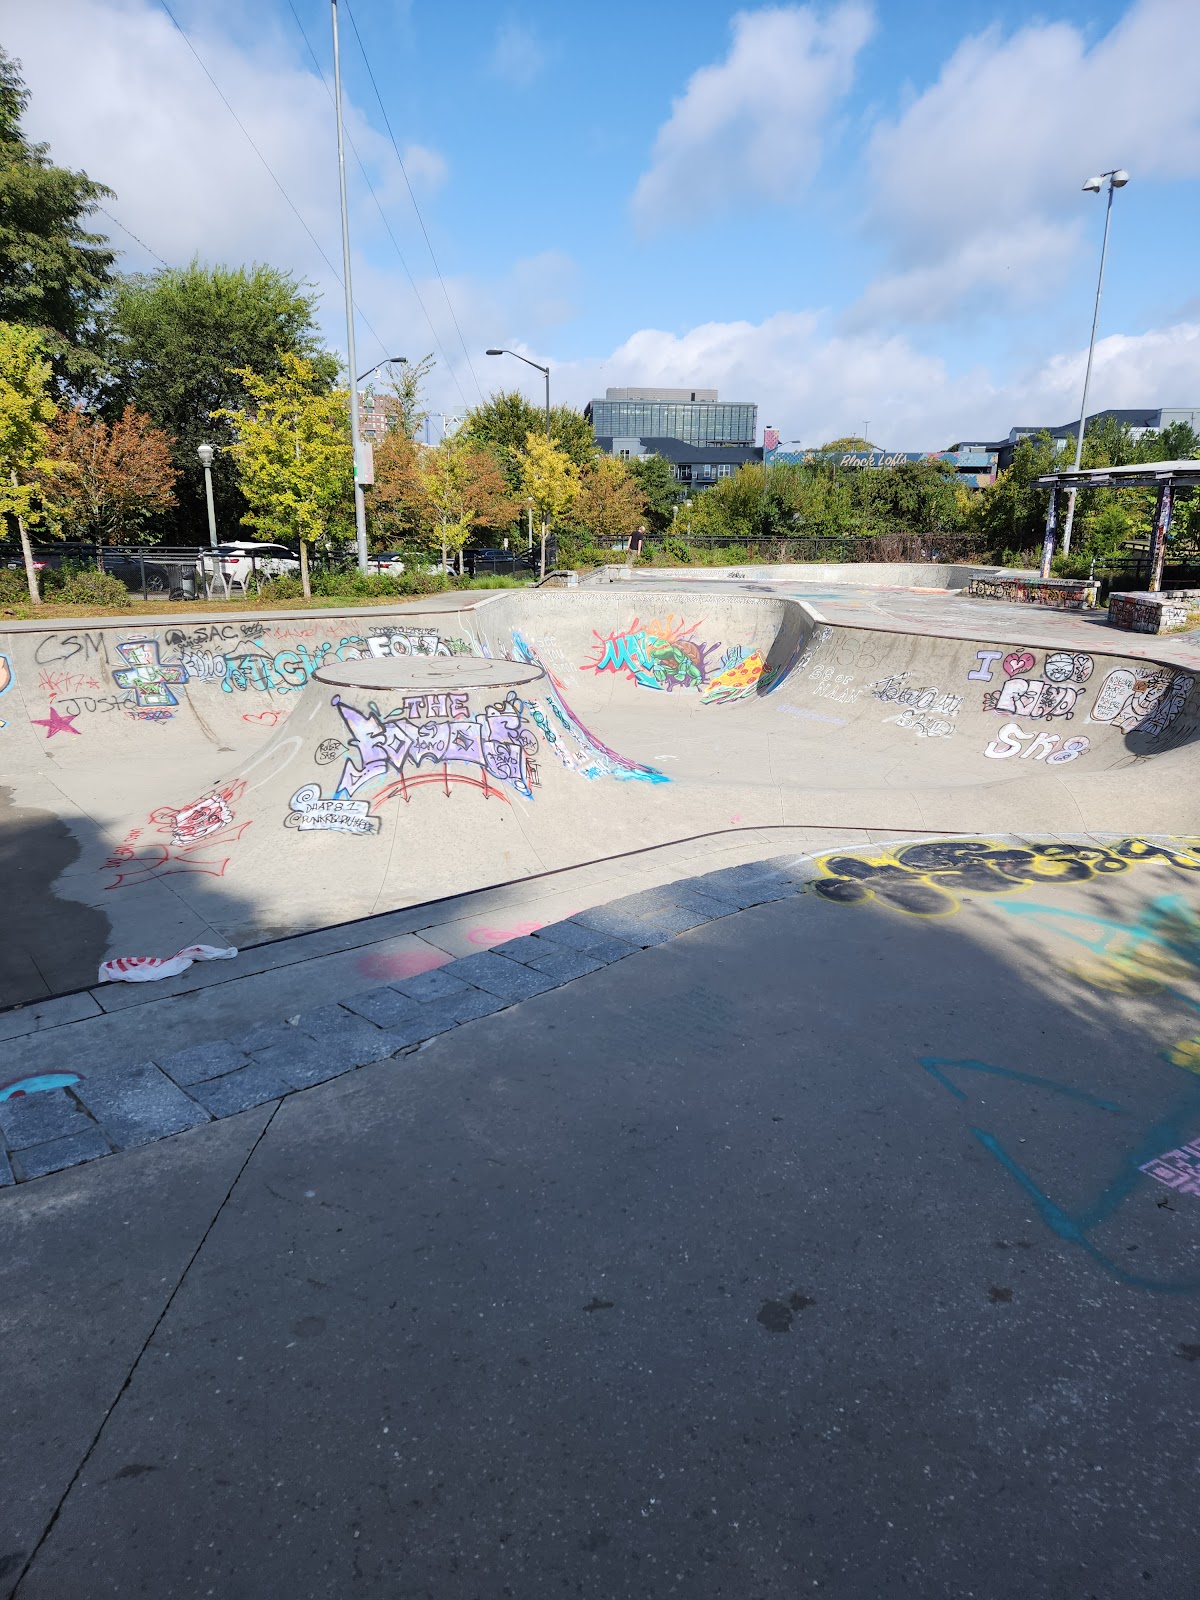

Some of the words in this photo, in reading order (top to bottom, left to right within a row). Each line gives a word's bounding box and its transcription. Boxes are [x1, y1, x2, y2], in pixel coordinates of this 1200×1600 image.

[840, 452, 876, 467] Block
[877, 452, 907, 467] Lofts
[34, 632, 110, 665] CSM
[967, 650, 1004, 682] I
[402, 692, 470, 719] THE
